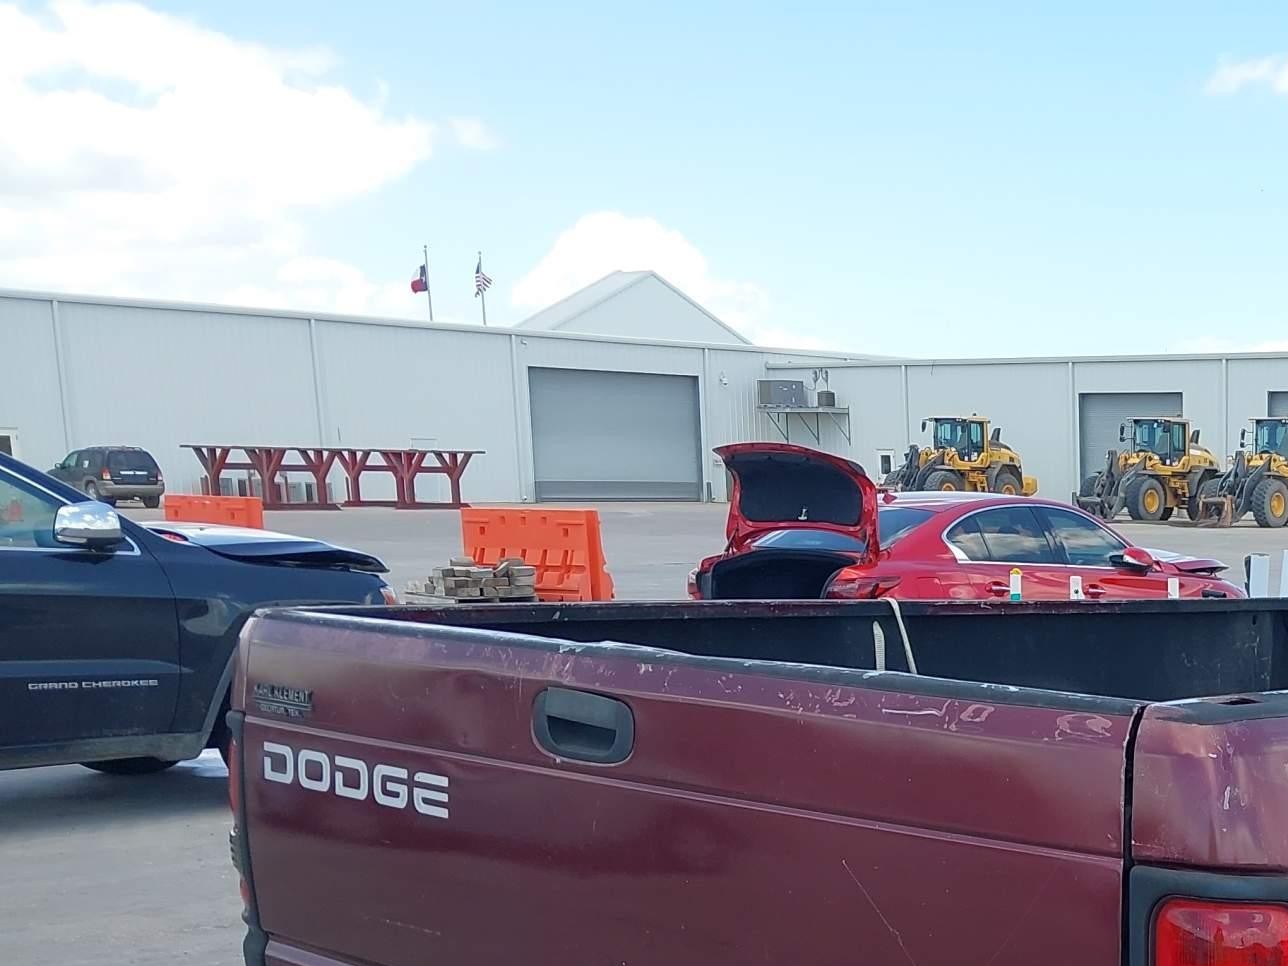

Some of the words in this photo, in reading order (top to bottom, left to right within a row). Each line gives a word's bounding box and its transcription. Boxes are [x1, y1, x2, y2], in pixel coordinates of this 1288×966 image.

[28, 682, 78, 690] GRAND
[82, 680, 158, 688] CHEROKEE
[264, 741, 449, 819] DODGE
